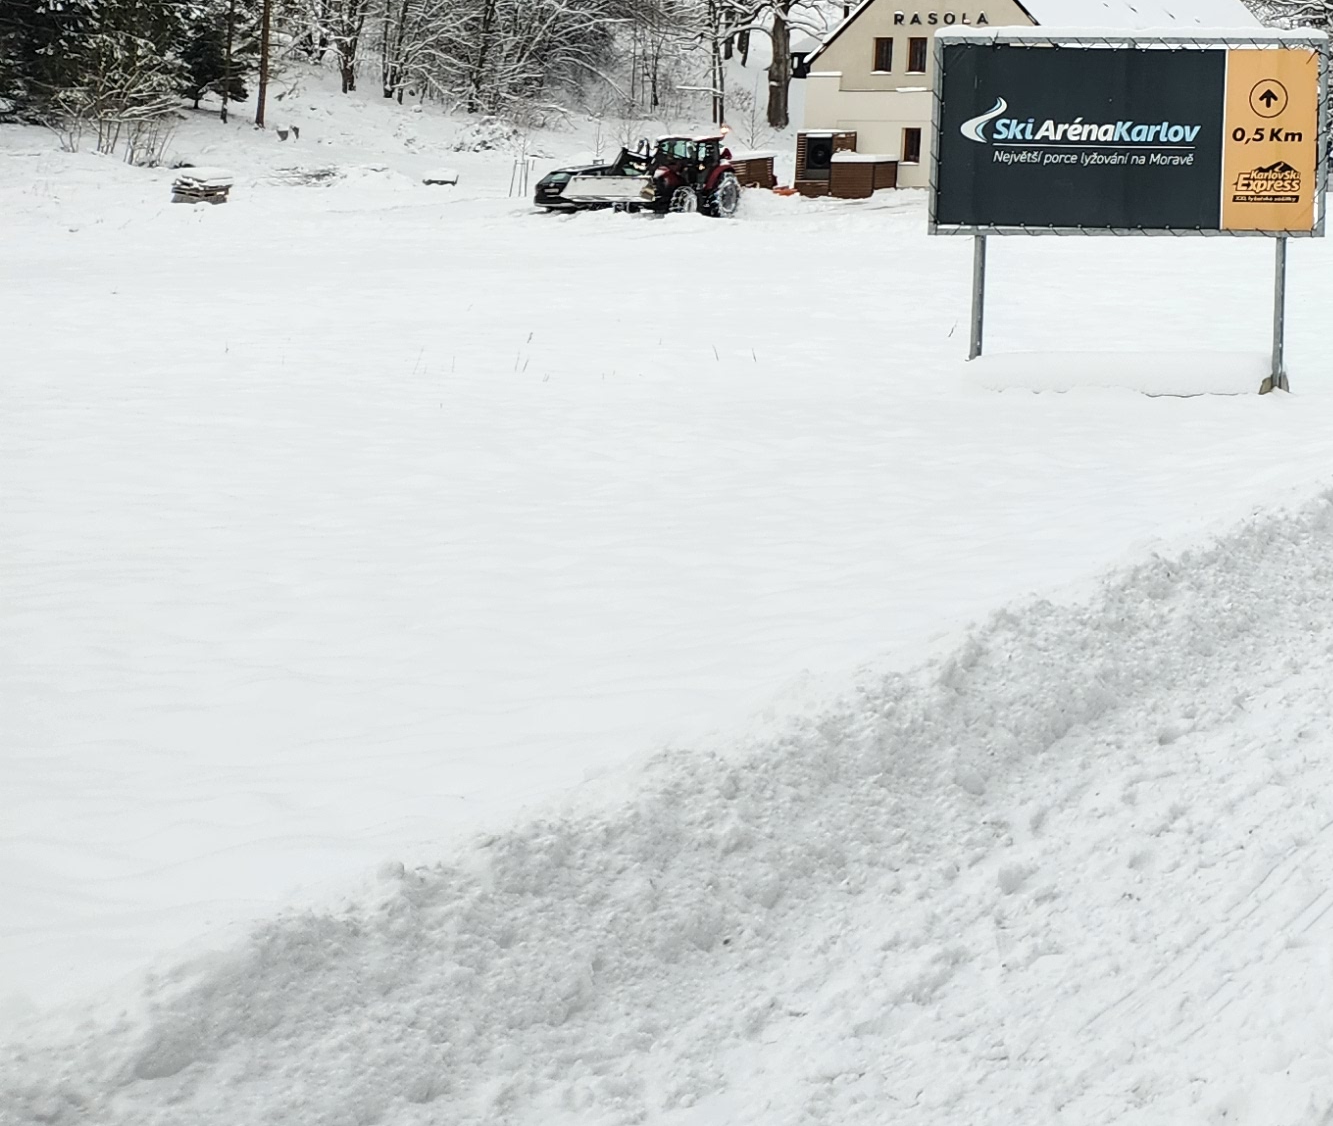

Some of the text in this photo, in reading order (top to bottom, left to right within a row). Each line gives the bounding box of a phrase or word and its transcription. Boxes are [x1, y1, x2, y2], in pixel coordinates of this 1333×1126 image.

[893, 12, 989, 25] RASOLA
[1232, 127, 1303, 145] 0,5 Km
[993, 150, 1194, 167] Největší porce lyžování na Moravě
[1236, 173, 1301, 193] Express
